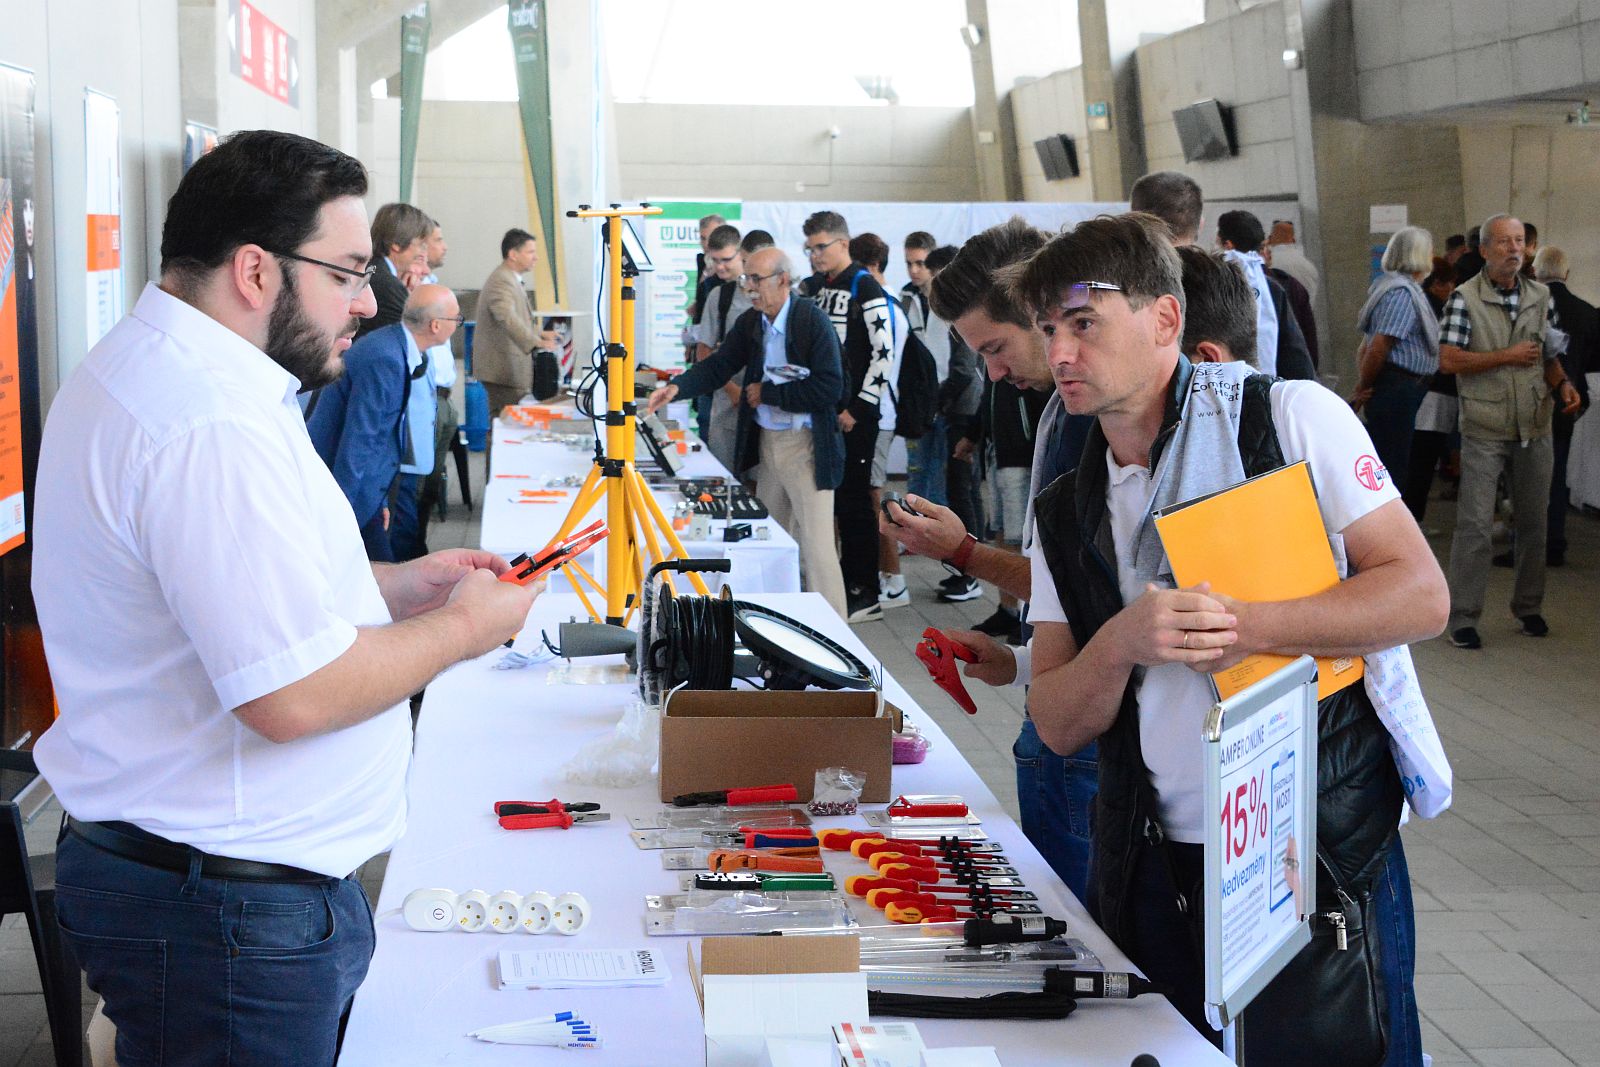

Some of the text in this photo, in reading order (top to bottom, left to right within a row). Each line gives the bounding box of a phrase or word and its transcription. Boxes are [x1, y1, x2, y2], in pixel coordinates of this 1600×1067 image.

[1191, 380, 1240, 394] Comfort
[1214, 387, 1240, 402] Heat
[1221, 768, 1267, 865] 15%
[1222, 850, 1267, 899] kedvezmény
